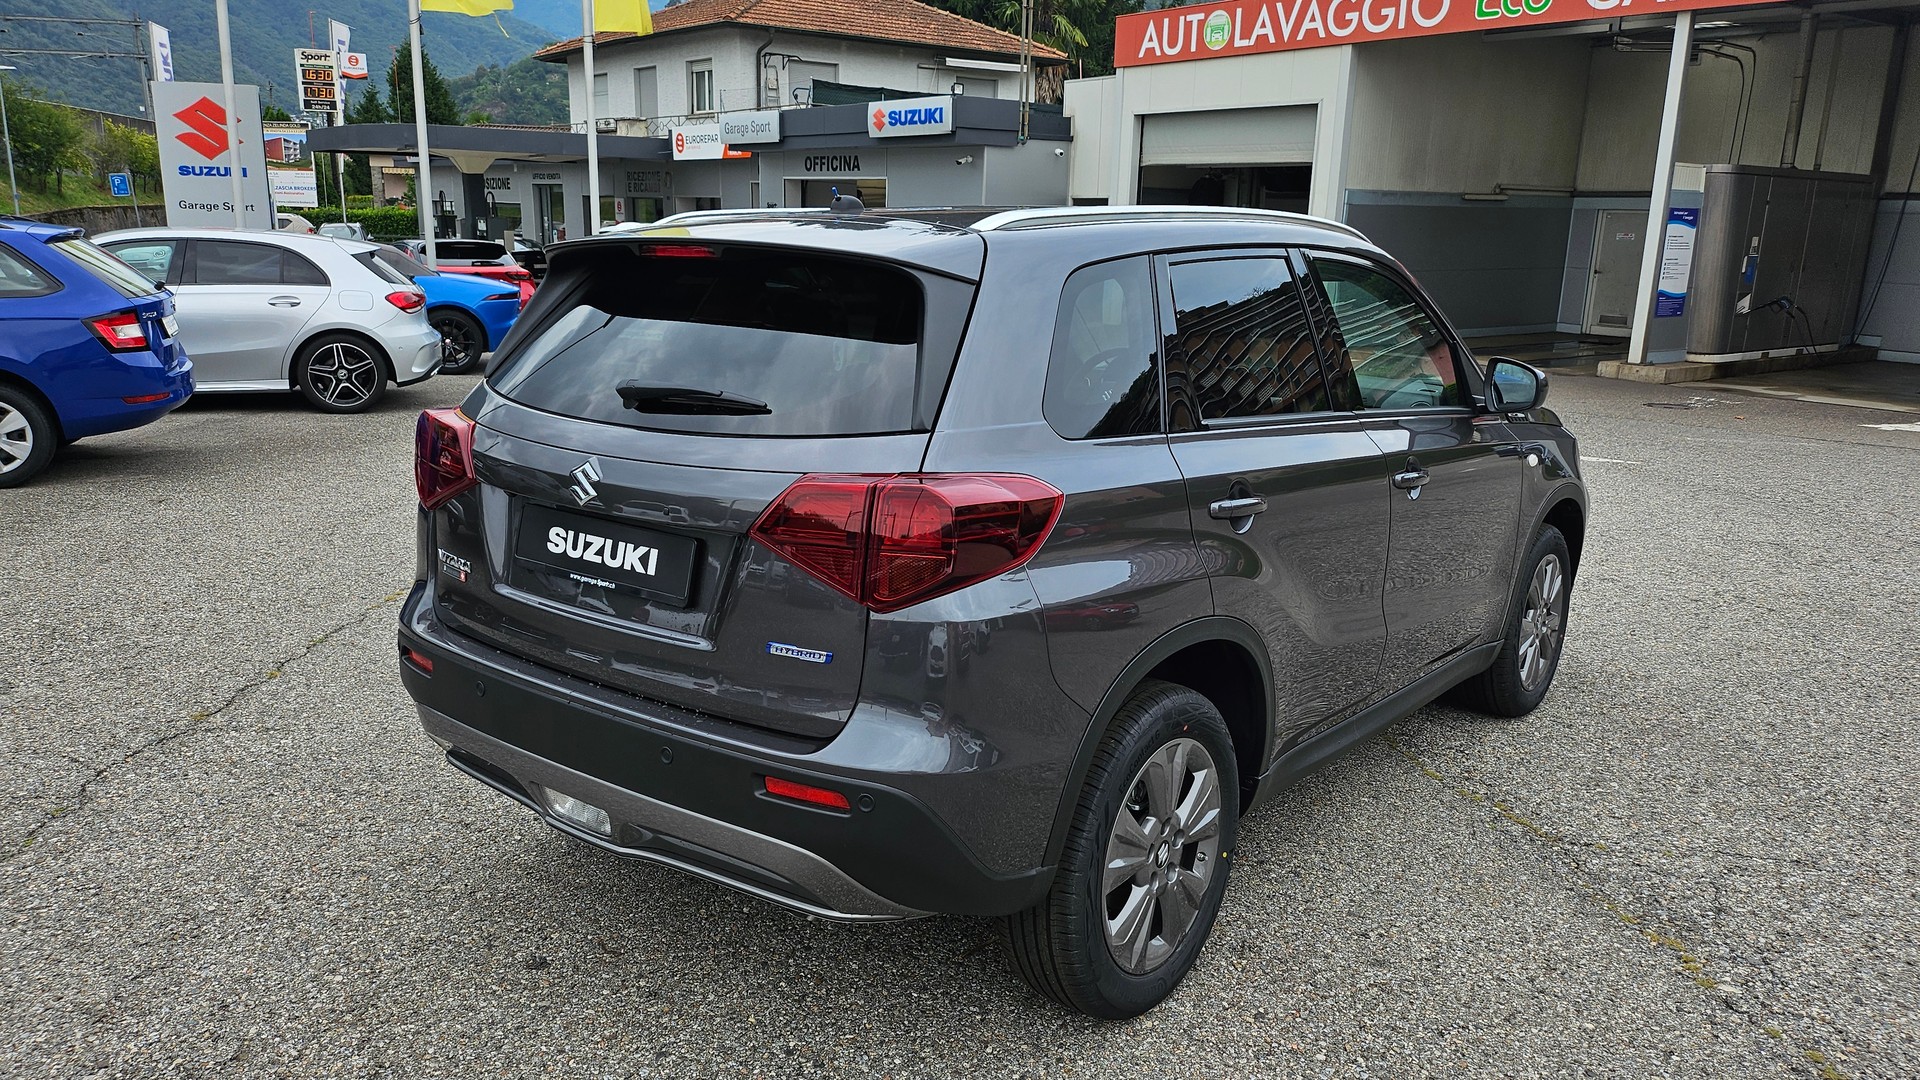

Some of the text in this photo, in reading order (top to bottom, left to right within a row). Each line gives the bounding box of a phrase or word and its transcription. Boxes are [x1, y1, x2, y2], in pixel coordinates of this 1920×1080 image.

[159, 41, 174, 81] UKI
[301, 51, 331, 62] Sport
[888, 107, 943, 127] SUZUKI
[724, 120, 771, 137] Garage Sport
[685, 134, 718, 145] EUROREPAR
[804, 155, 861, 172] OFFICINA
[178, 165, 248, 178] SUZUI
[626, 171, 661, 181] RICEZIONE
[485, 177, 511, 190] SIZIONE
[628, 182, 632, 192] E
[178, 200, 255, 214] Garage Srt
[546, 526, 659, 576] SUZUKI
[775, 646, 822, 660] HYBRID
